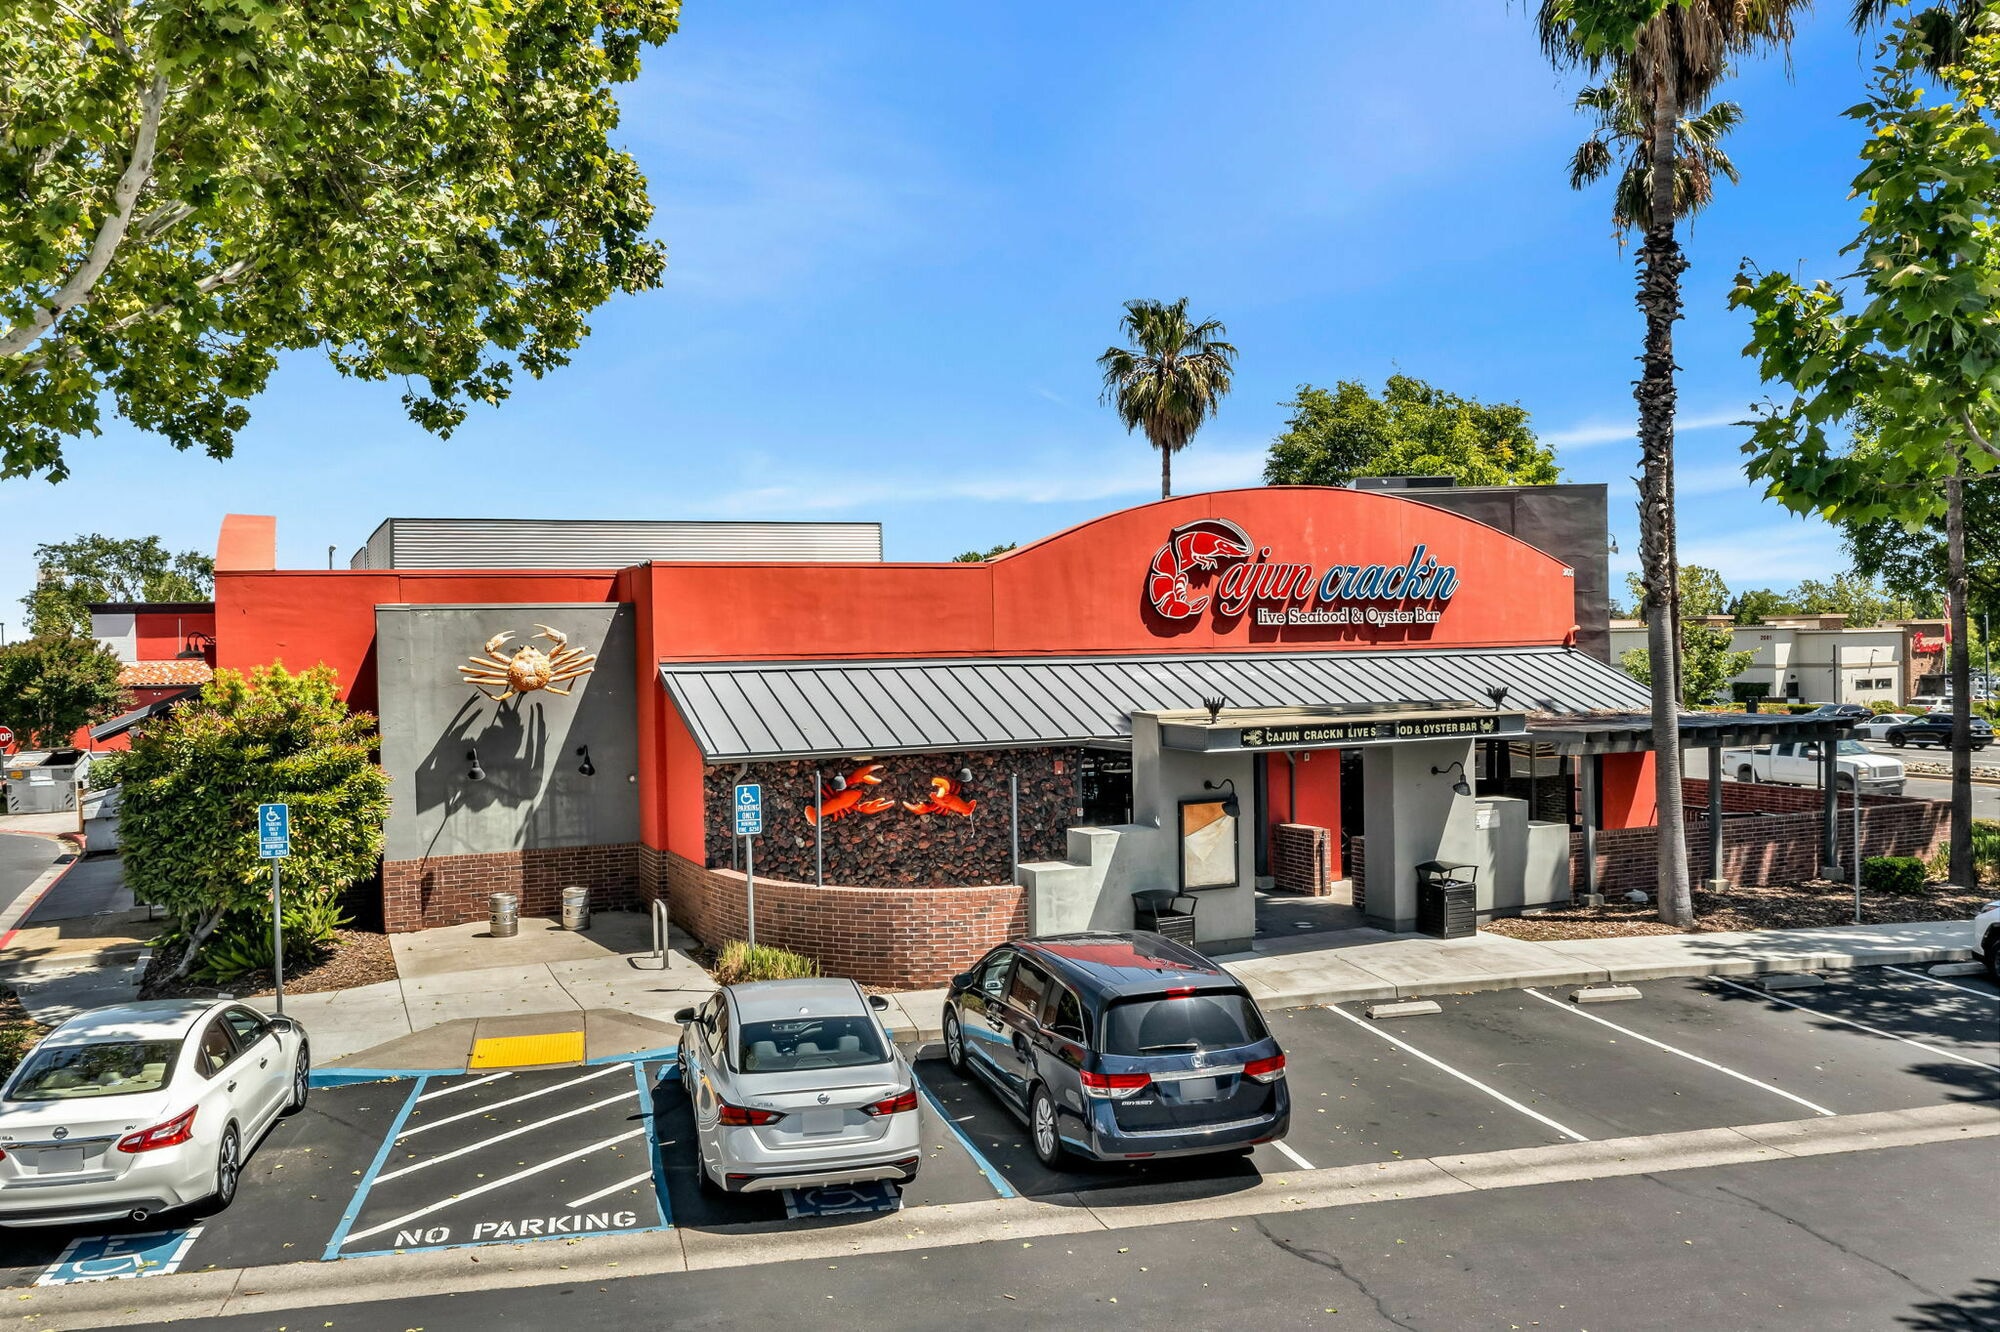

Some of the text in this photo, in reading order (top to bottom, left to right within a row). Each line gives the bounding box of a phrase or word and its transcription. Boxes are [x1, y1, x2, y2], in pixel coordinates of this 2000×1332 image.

[1257, 607, 1441, 627] live Seafood & Oyster Bar
[1265, 731, 1300, 743] CAJUN
[1303, 728, 1344, 741] CRACKN
[1347, 727, 1369, 738] LIVE
[1414, 725, 1422, 735] &
[1422, 722, 1459, 734] OYSTER
[1459, 722, 1478, 732] BAR
[394, 1211, 637, 1247] NO PARKING
